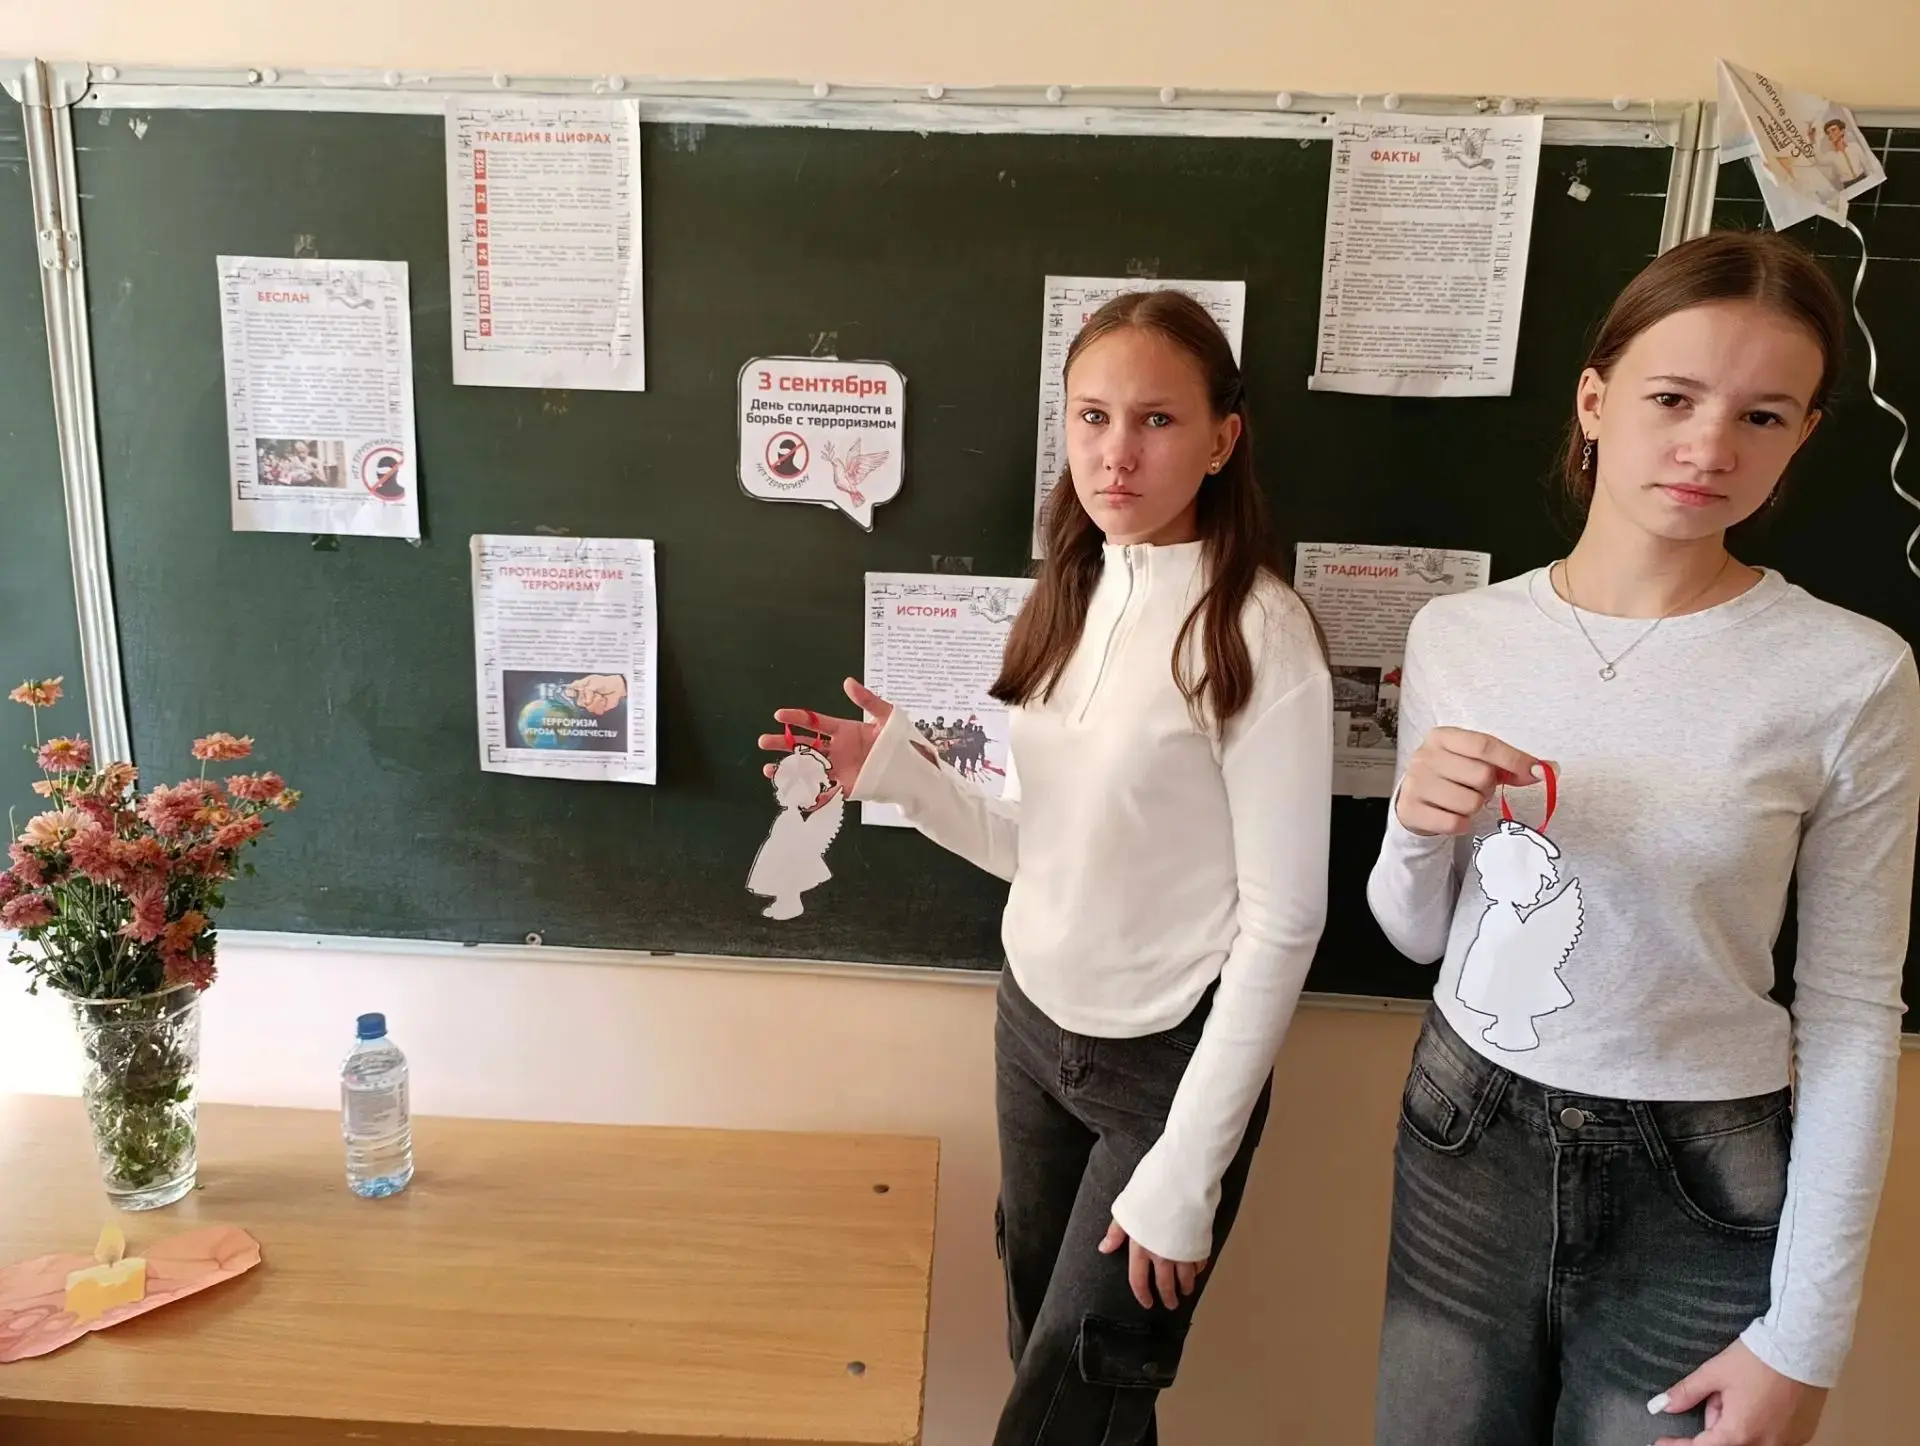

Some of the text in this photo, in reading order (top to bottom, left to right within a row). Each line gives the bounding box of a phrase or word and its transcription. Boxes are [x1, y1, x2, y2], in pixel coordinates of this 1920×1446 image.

[475, 131, 611, 145] ТРАГЕДИЯ В ЦИФРАХ
[1783, 117, 1815, 159] дружбу
[1370, 150, 1420, 163] ФАКТЫ
[257, 291, 310, 304] БЕСЛАН
[758, 371, 887, 398] 3 сентября
[750, 398, 892, 416] День солидарности в
[746, 412, 896, 430] борьбе с терроризмом
[499, 566, 624, 580] ПРОТИВОДЕЙСТВИЕ
[1323, 563, 1398, 578] ТРАДИЦИИ
[521, 580, 601, 591] ТЕРРОРИЗМУ
[896, 605, 957, 618] ИСТОРИЯ
[542, 717, 598, 728] ТЕРРОРИЗМ
[556, 728, 618, 738] ЧЕЛОВЕЧЕСТВУ
